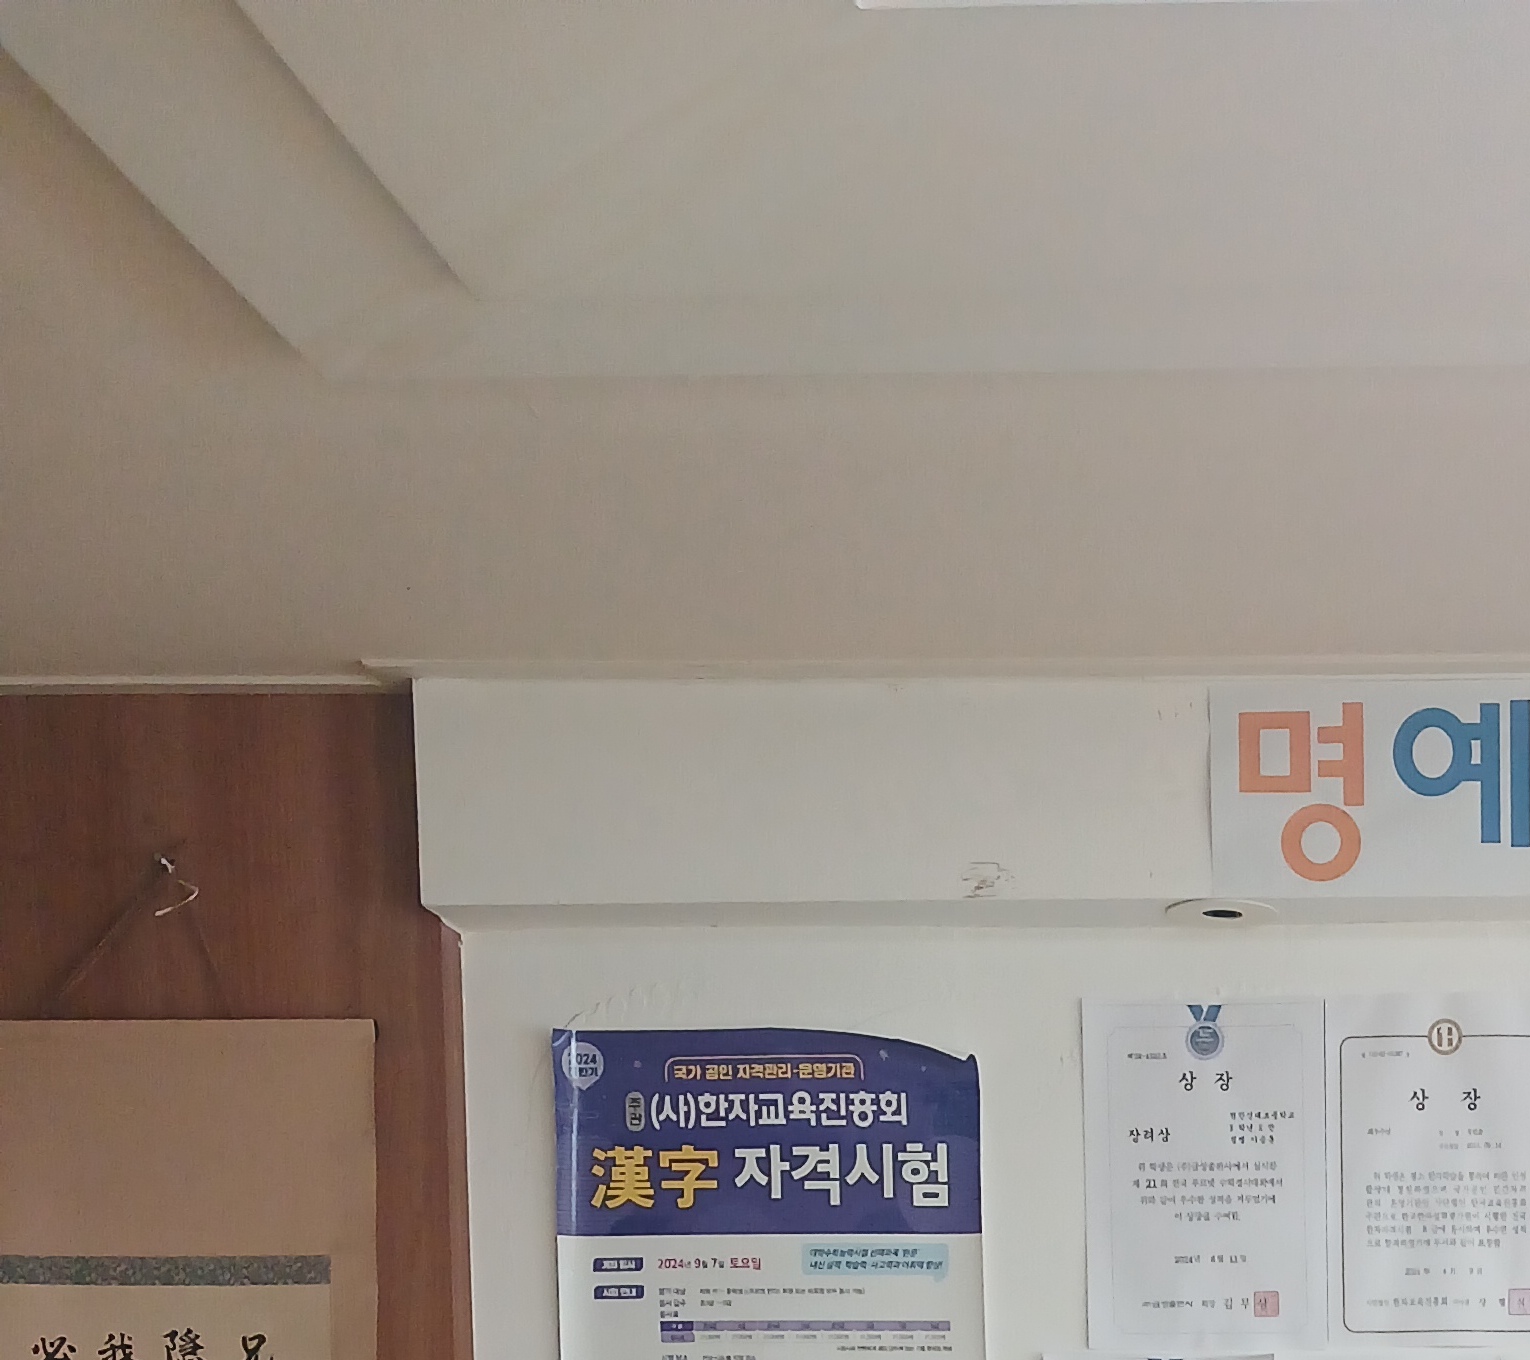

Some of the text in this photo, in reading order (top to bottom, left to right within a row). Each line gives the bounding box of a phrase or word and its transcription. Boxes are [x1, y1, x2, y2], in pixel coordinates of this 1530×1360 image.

[591, 1142, 949, 1209] 漢字 자격시험
[730, 1257, 761, 1270] 토요일
